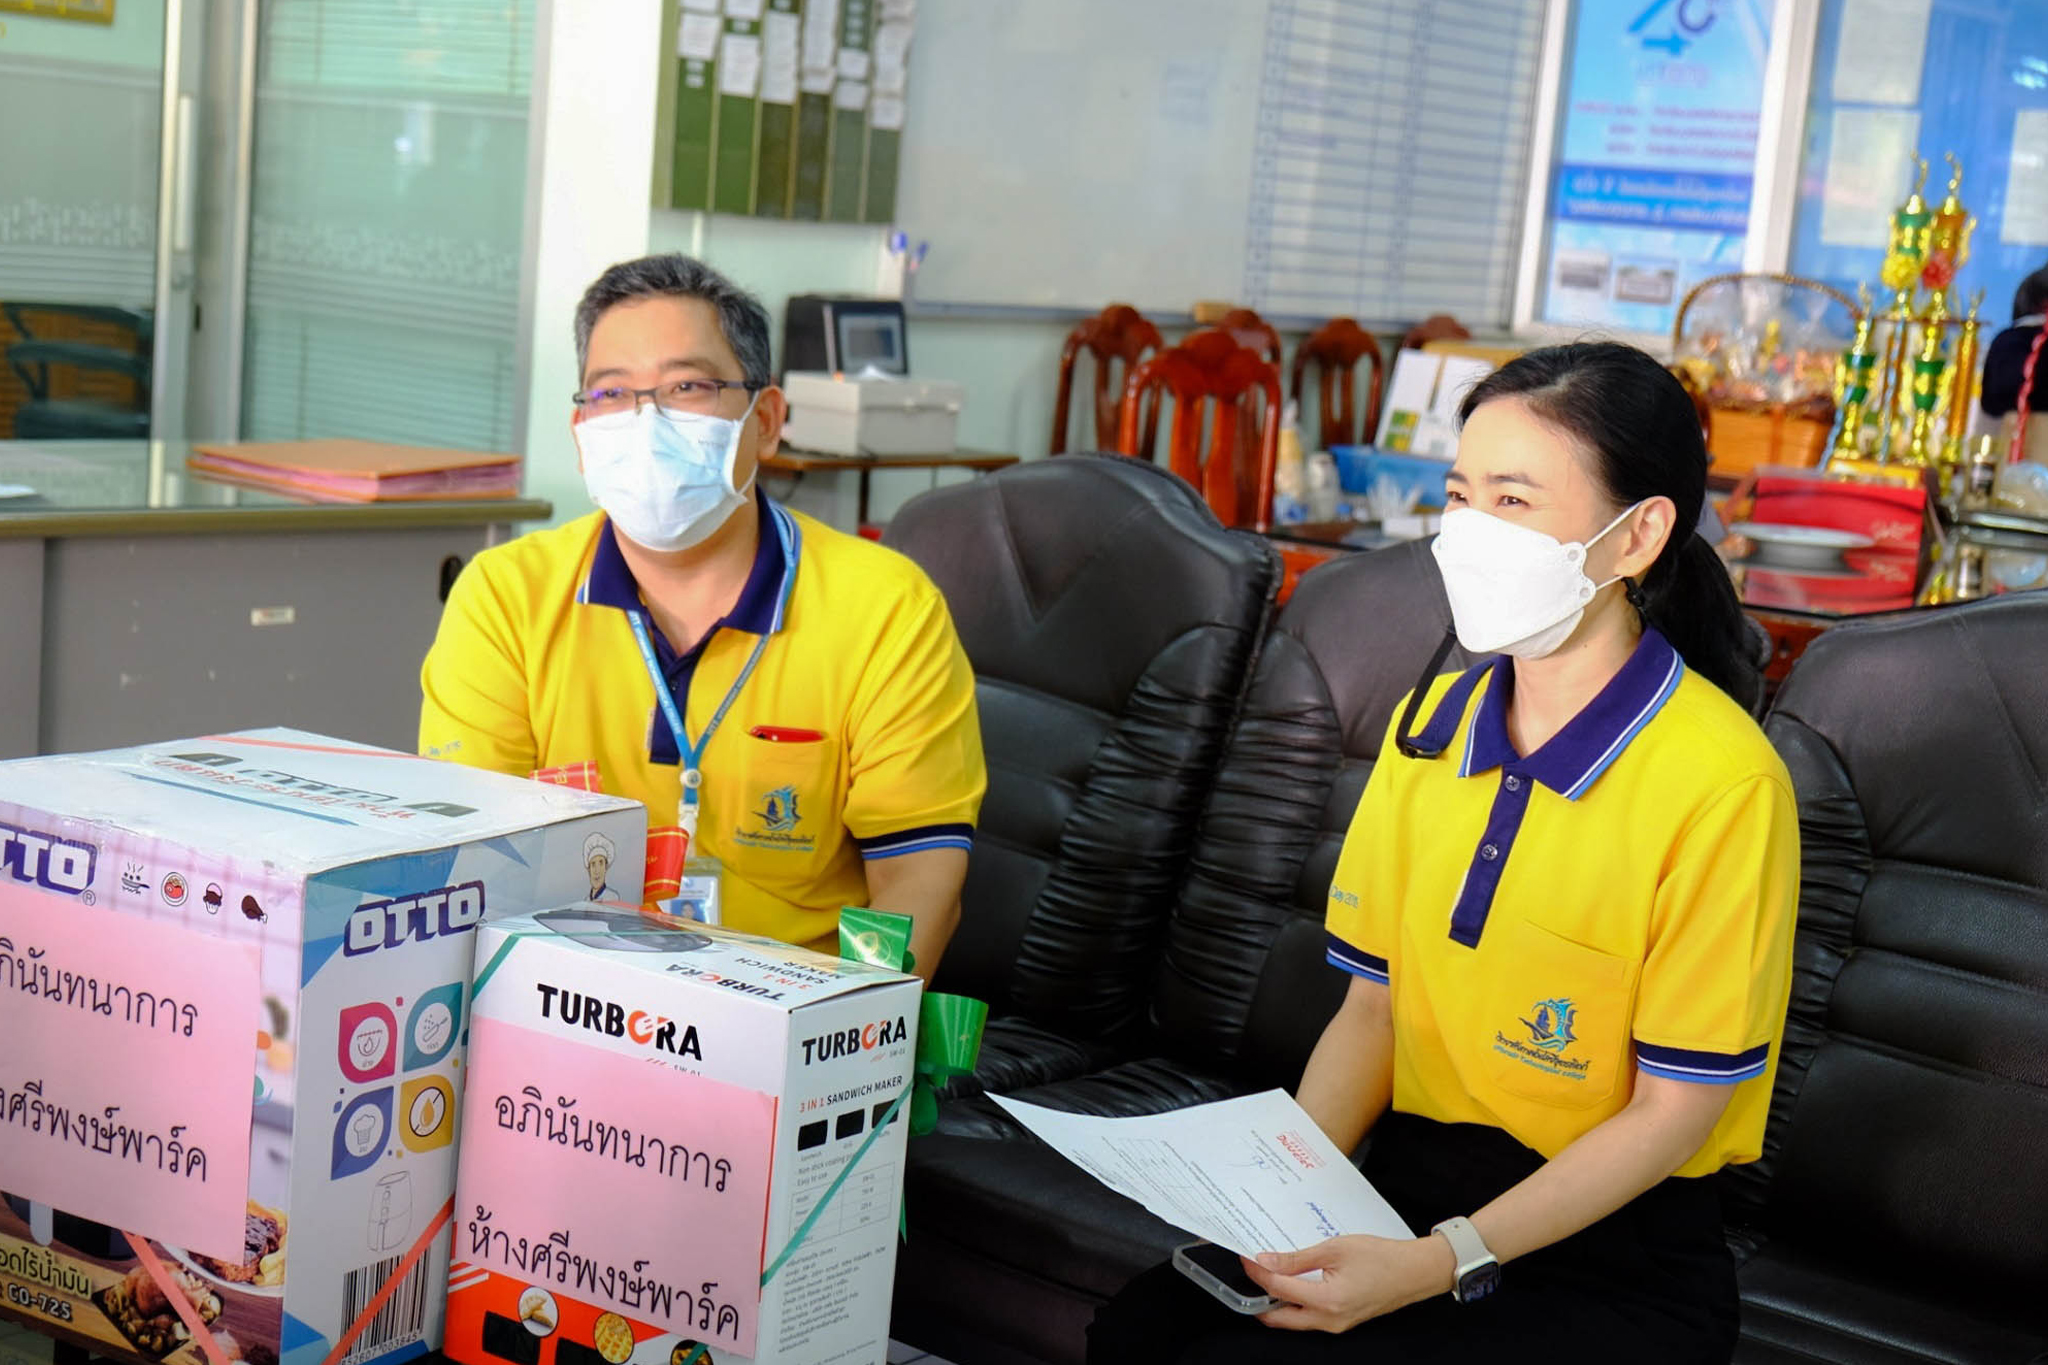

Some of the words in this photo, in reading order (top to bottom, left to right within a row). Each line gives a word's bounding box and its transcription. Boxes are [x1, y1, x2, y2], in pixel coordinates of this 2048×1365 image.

[0, 822, 97, 894] TO
[344, 880, 485, 957] OTTO
[666, 964, 785, 1000] TURBORA
[735, 958, 829, 984] SANDWICH
[777, 978, 797, 986] IN
[784, 962, 845, 979] MAKER
[537, 983, 702, 1061] TURBORA
[802, 1016, 906, 1066] TURBORA
[800, 1102, 805, 1113] 3
[808, 1098, 817, 1111] IN
[820, 1097, 825, 1107] 1
[827, 1084, 872, 1106] SANDWICH
[875, 1075, 903, 1091] MAKER
[0, 1080, 206, 1182] ศรีพงษ์พาร์ค
[495, 1086, 732, 1192] อภินันทนาการ
[469, 1205, 739, 1340] ห้างศรีพงษ์พาร์ค
[9, 1284, 72, 1320] CO-725
